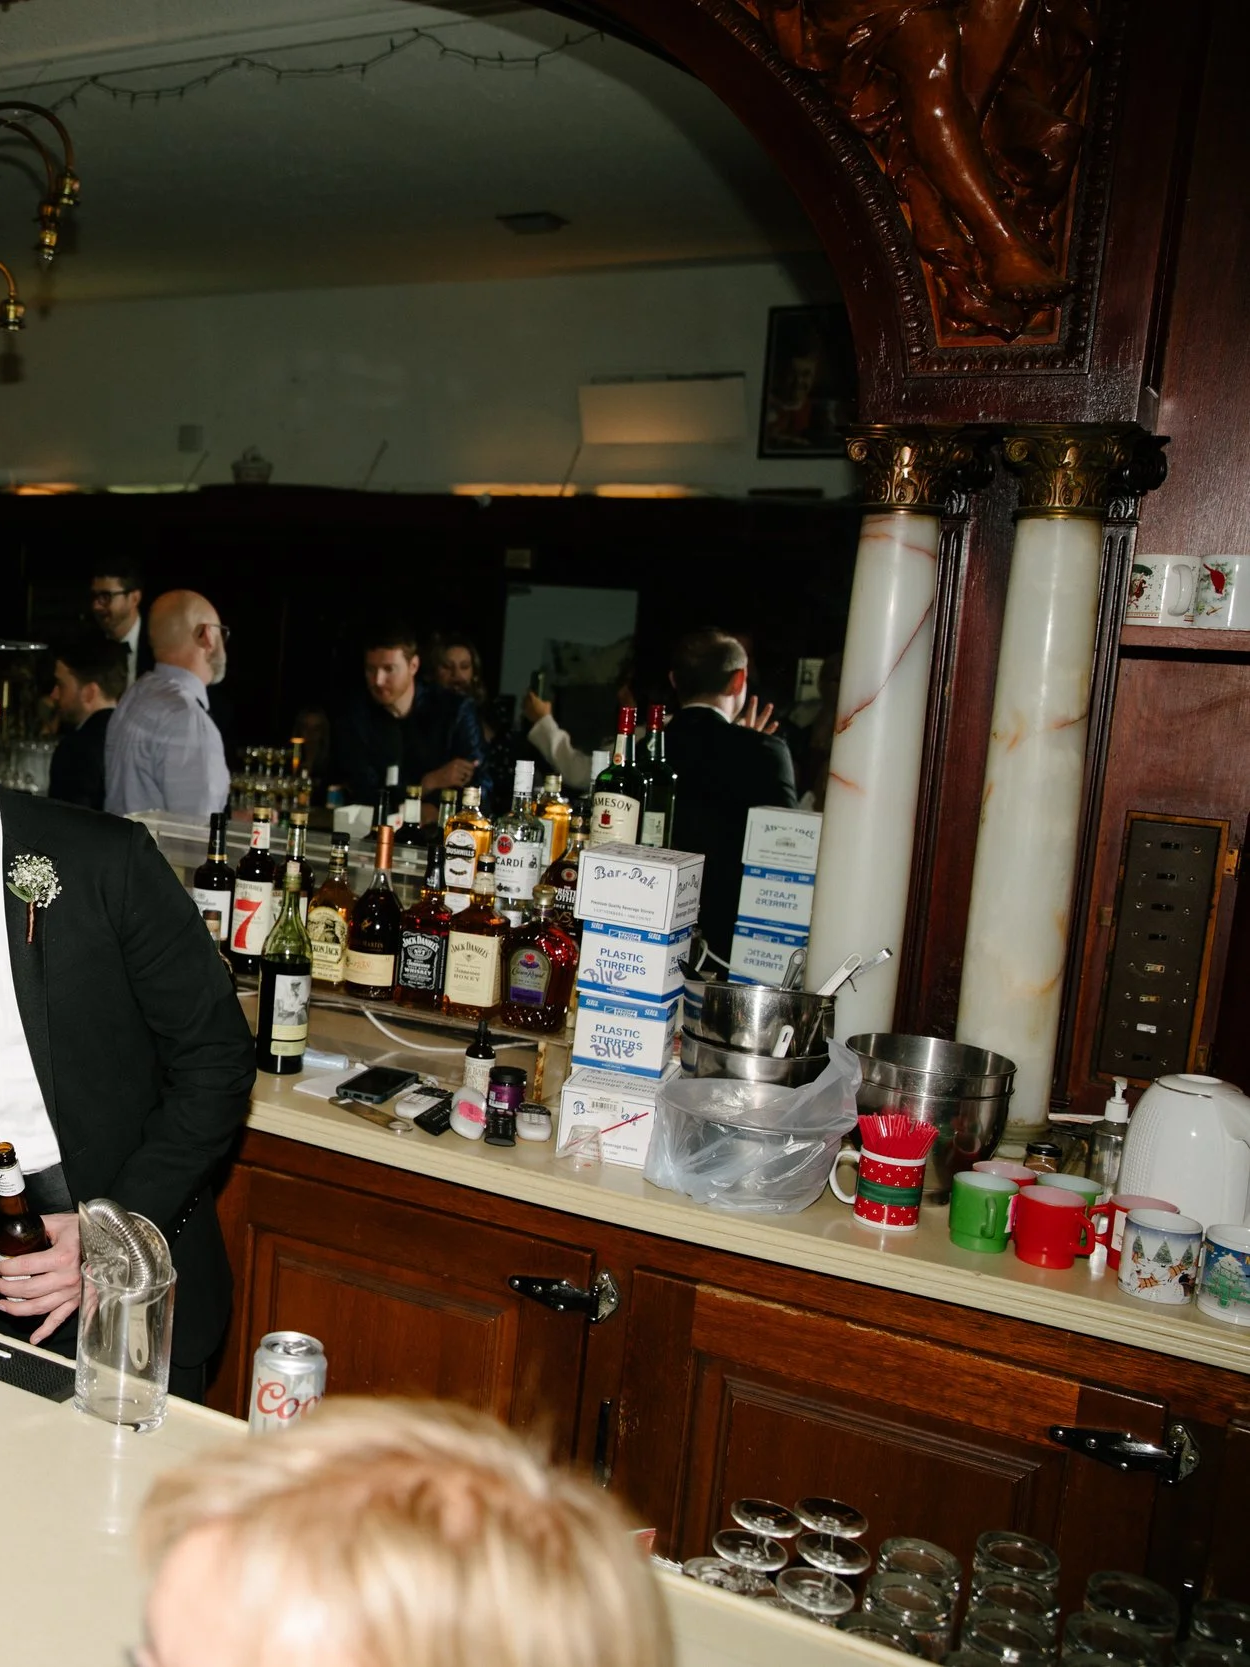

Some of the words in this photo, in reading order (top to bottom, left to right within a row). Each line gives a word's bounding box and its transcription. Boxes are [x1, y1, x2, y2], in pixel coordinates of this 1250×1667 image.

[594, 796, 632, 812] AMESON
[253, 831, 260, 846] 7
[495, 856, 524, 868] CARDÍ
[234, 898, 262, 949] 7
[402, 936, 417, 948] JACK
[450, 943, 466, 953] JACK
[600, 948, 644, 963] PLASTIC
[595, 958, 647, 976] STIRRERS
[453, 973, 480, 982] HONEY
[583, 966, 627, 984] Blue
[595, 1024, 640, 1039] PLASTIC
[590, 1035, 643, 1051] STIRRERS
